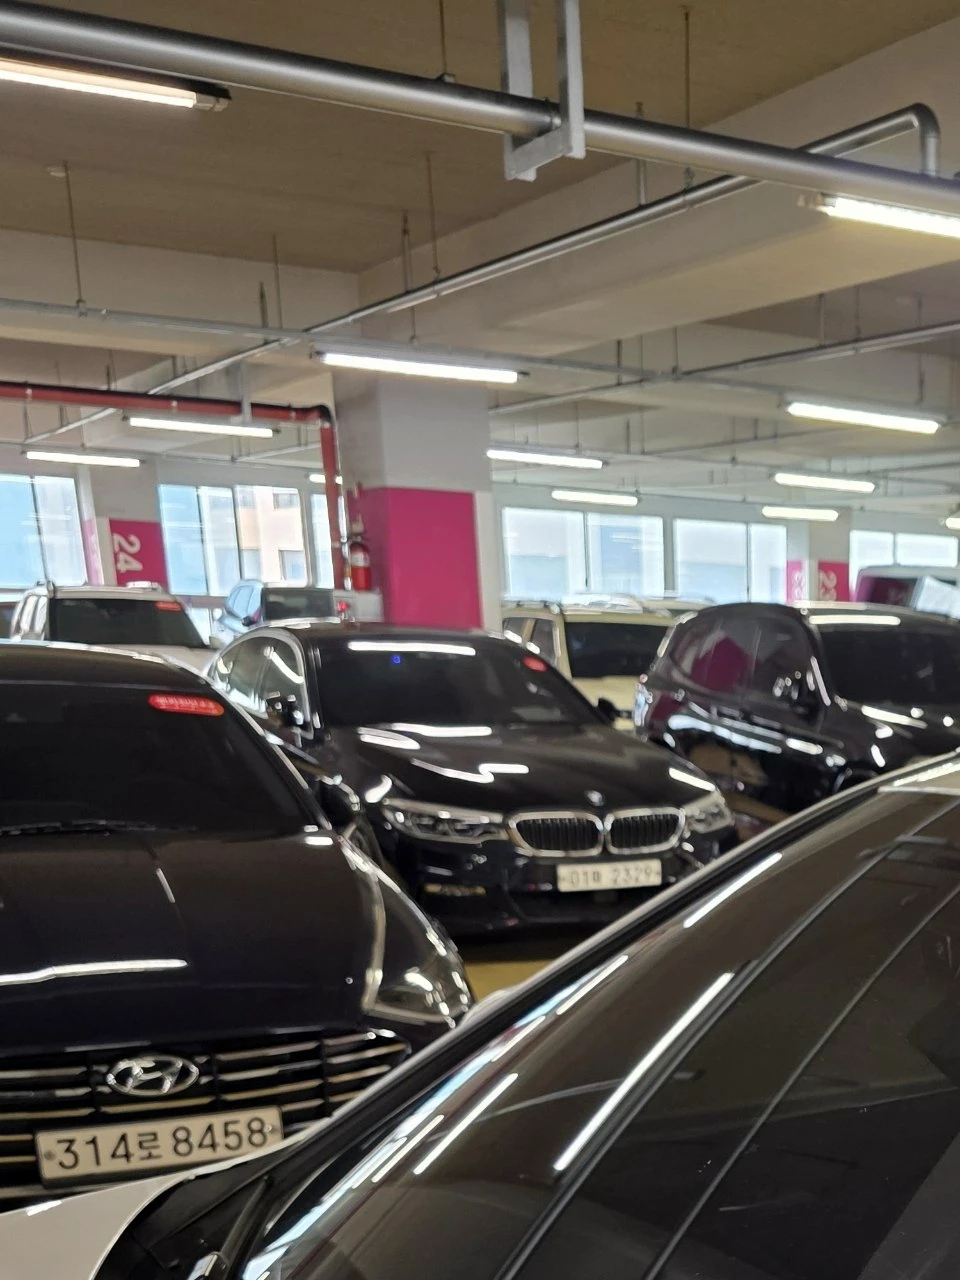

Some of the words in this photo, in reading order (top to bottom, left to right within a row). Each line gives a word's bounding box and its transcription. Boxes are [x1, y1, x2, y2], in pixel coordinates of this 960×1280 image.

[112, 532, 144, 573] 24
[55, 1130, 163, 1171] 314로
[171, 1116, 270, 1157] 8458
